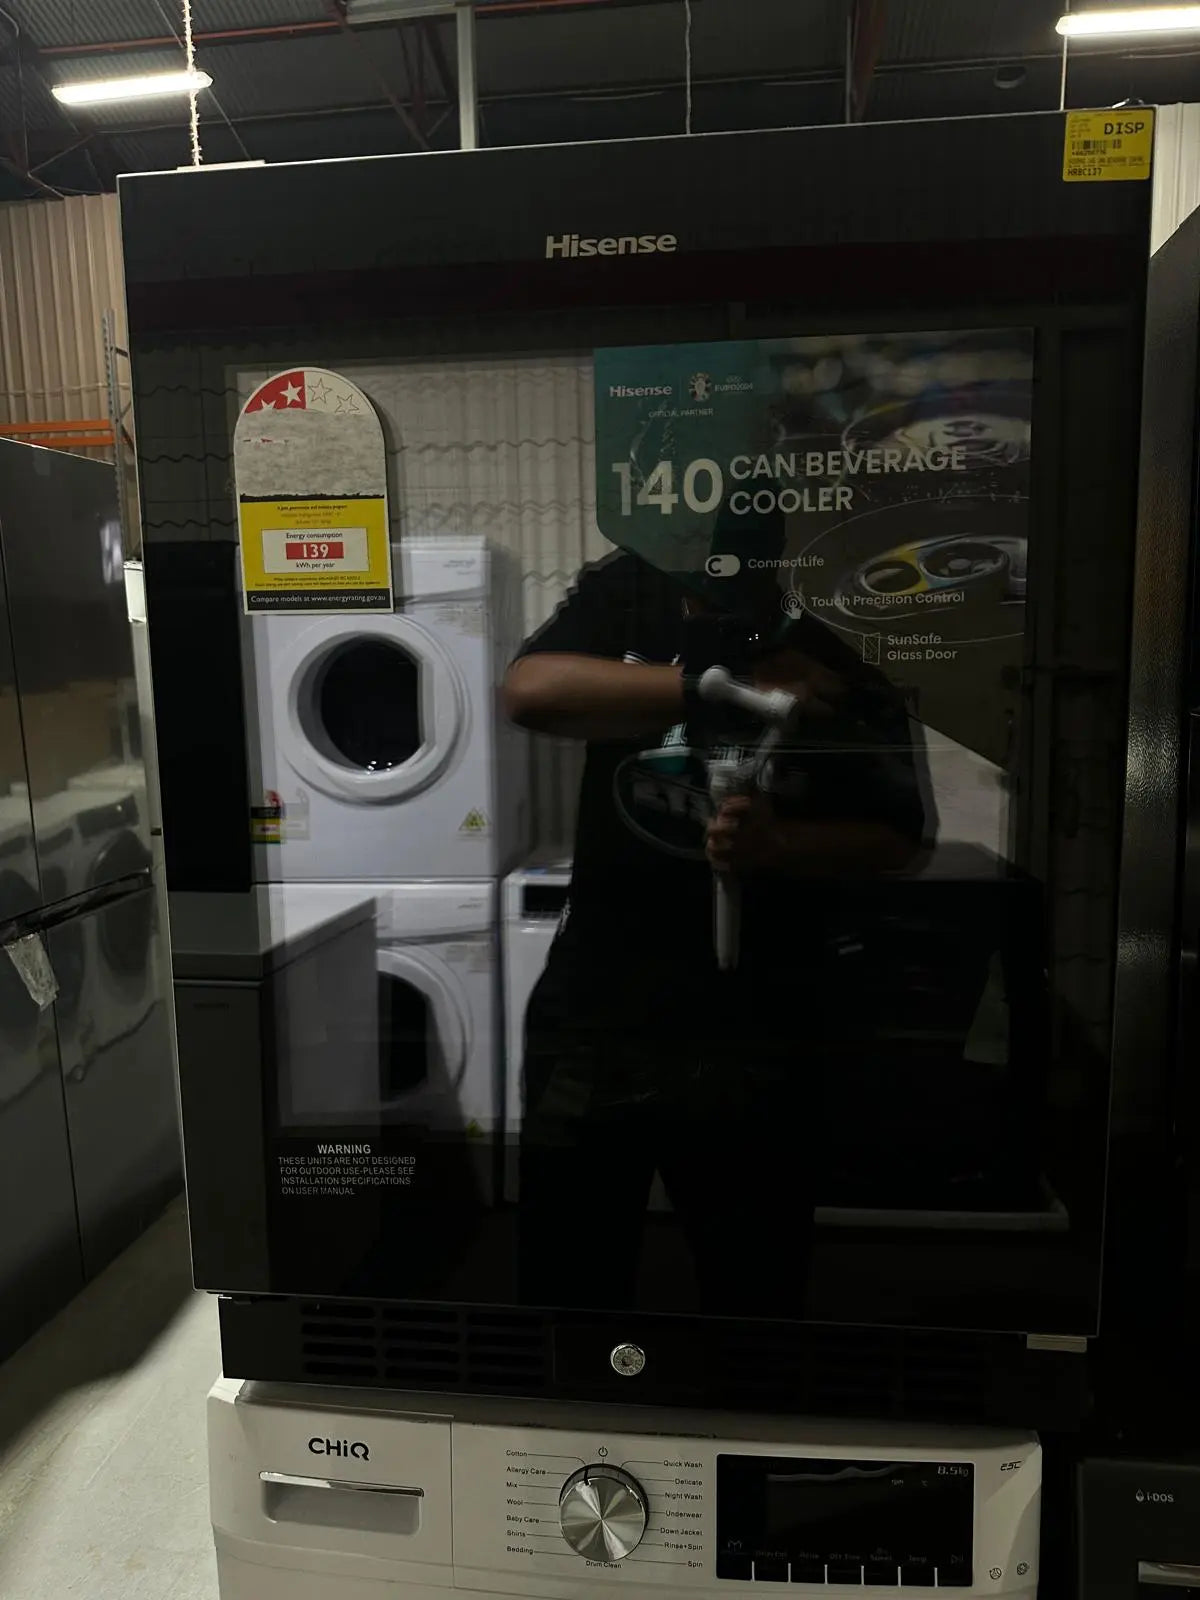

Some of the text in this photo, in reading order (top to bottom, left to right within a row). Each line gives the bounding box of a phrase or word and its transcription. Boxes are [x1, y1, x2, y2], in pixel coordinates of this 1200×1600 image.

[1104, 122, 1145, 135] DISP
[545, 234, 678, 259] Hisense
[609, 385, 672, 397] Hisense
[681, 408, 714, 417] PARTNER
[729, 446, 967, 480] CAN BEVERAGE
[611, 458, 724, 516] 140
[729, 486, 854, 516] COOLER
[286, 532, 305, 540] Energy
[302, 543, 329, 558] 139
[748, 556, 825, 569] ConnectLife
[251, 595, 279, 604] Compare
[811, 591, 966, 608] Touch Precision Control
[887, 633, 943, 646] SunSafe
[887, 652, 958, 662] Glass Door
[317, 1144, 372, 1154] WARNING
[279, 1156, 416, 1165] THESE UNITS ARE NOT DESIGNED
[280, 1166, 415, 1175] FOR OUTDOOR USE-PLEASE SEE
[281, 1176, 411, 1185] INSTALLATION SPECIFICATIONS
[282, 1186, 355, 1195] ON USER MANUAL
[308, 1437, 370, 1461] CHiQ
[506, 1449, 528, 1457] Cotton
[663, 1460, 682, 1468] Quick
[506, 1466, 546, 1475] Allergy Care
[674, 1478, 703, 1486] Delicate
[665, 1492, 682, 1500] Night
[665, 1510, 703, 1518] Underwear
[506, 1515, 522, 1523] Baby
[660, 1527, 703, 1536] Down Jacket
[506, 1546, 534, 1555] Bedding
[687, 1561, 703, 1569] Spin
